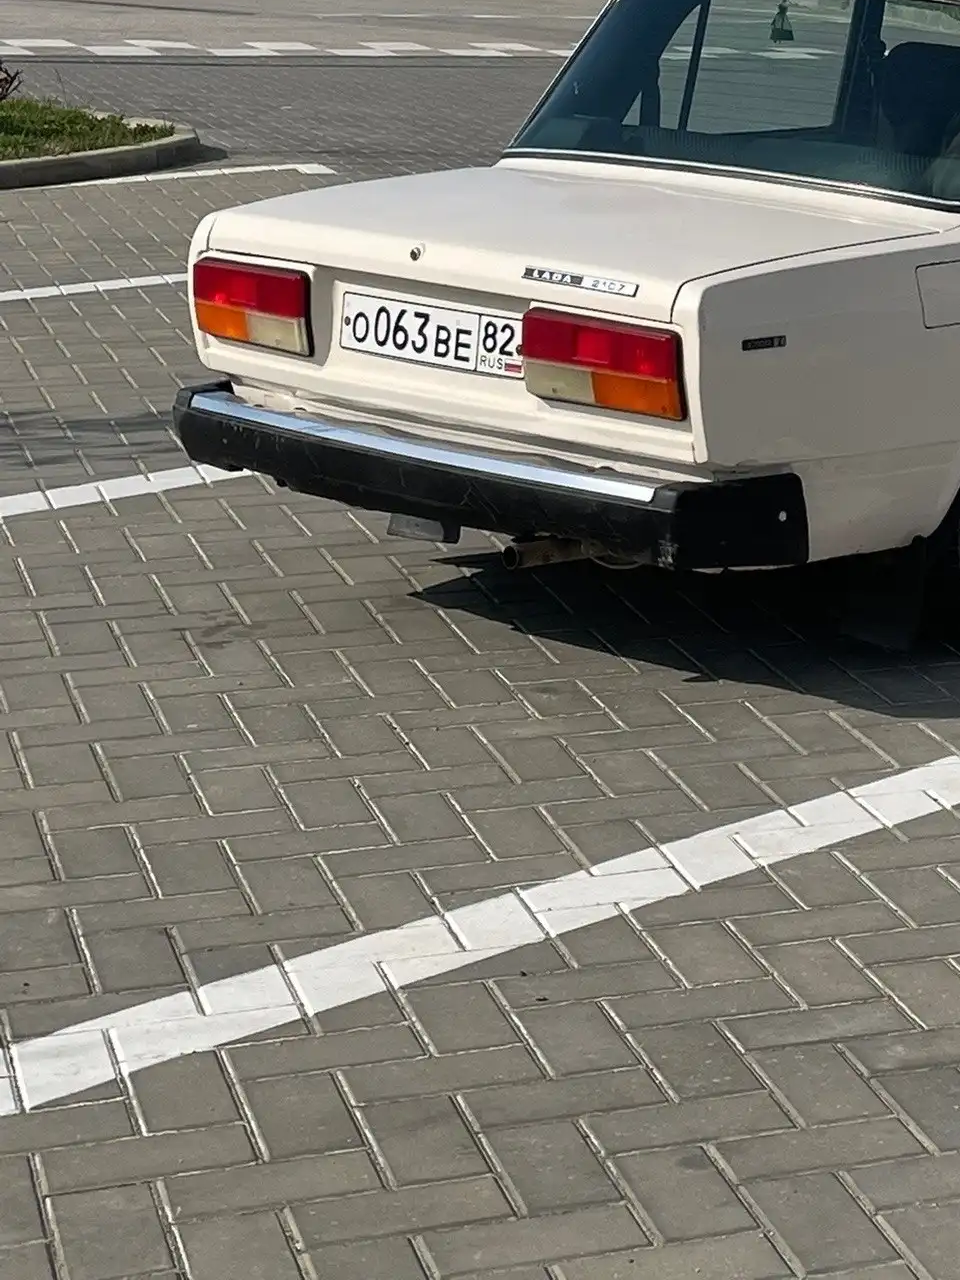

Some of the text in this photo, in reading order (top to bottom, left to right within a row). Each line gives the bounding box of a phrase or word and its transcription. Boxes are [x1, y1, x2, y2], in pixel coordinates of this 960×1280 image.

[532, 268, 572, 284] LADA
[482, 320, 516, 357] 82
[479, 354, 504, 370] RUS
